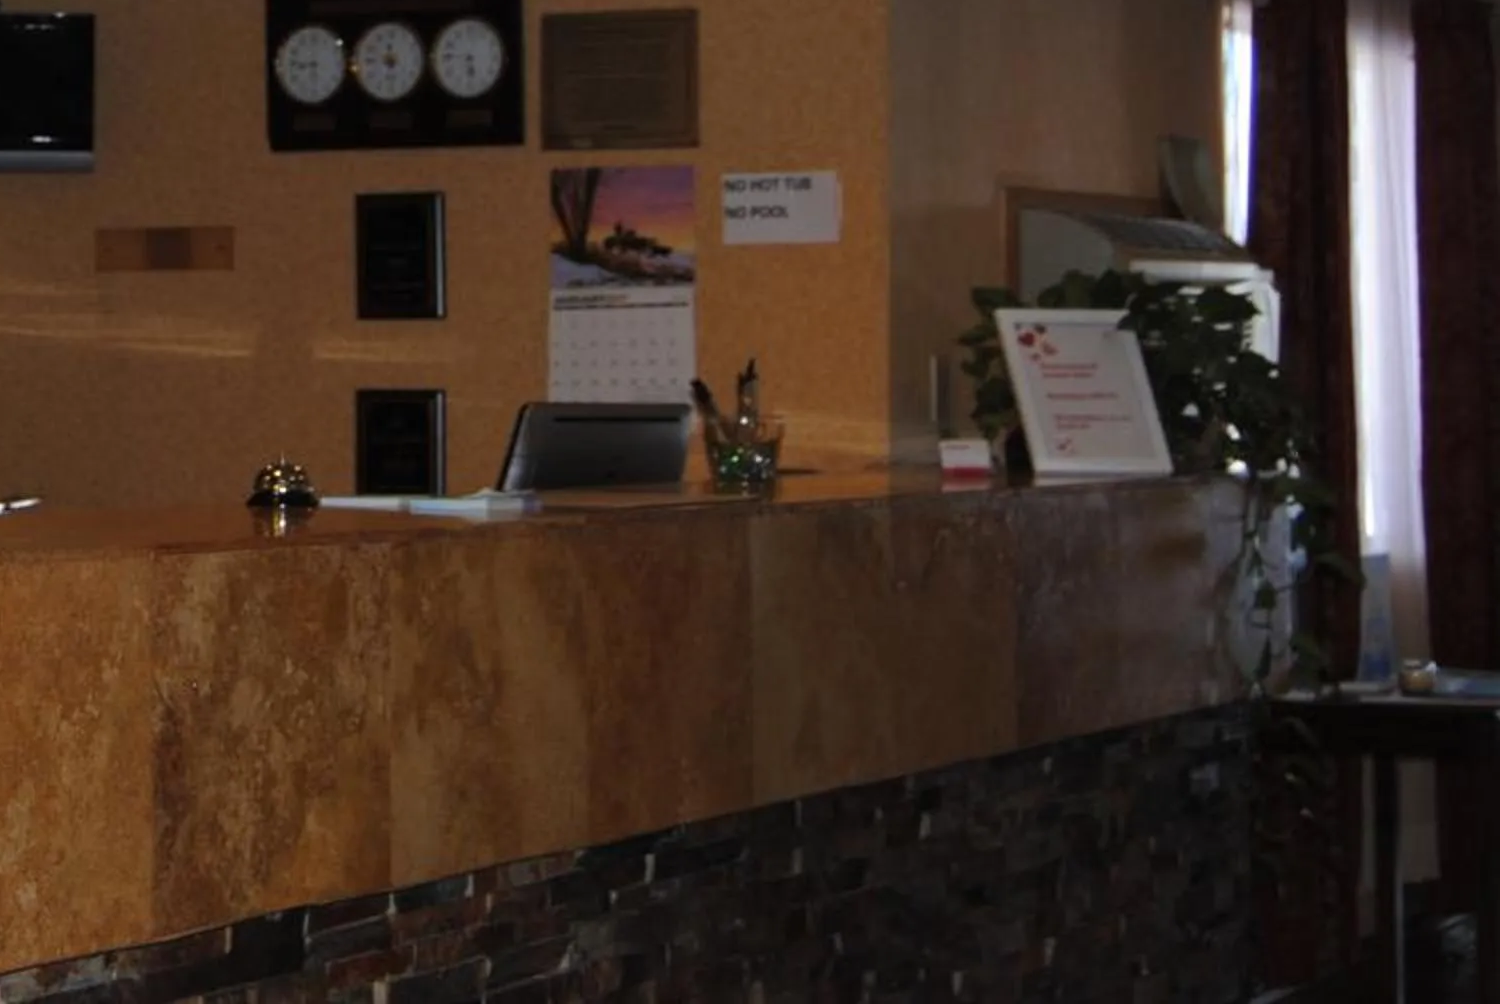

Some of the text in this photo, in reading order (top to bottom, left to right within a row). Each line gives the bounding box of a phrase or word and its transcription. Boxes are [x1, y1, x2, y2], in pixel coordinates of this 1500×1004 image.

[724, 177, 812, 191] NO HOT TUB
[724, 205, 789, 219] NO POOL
